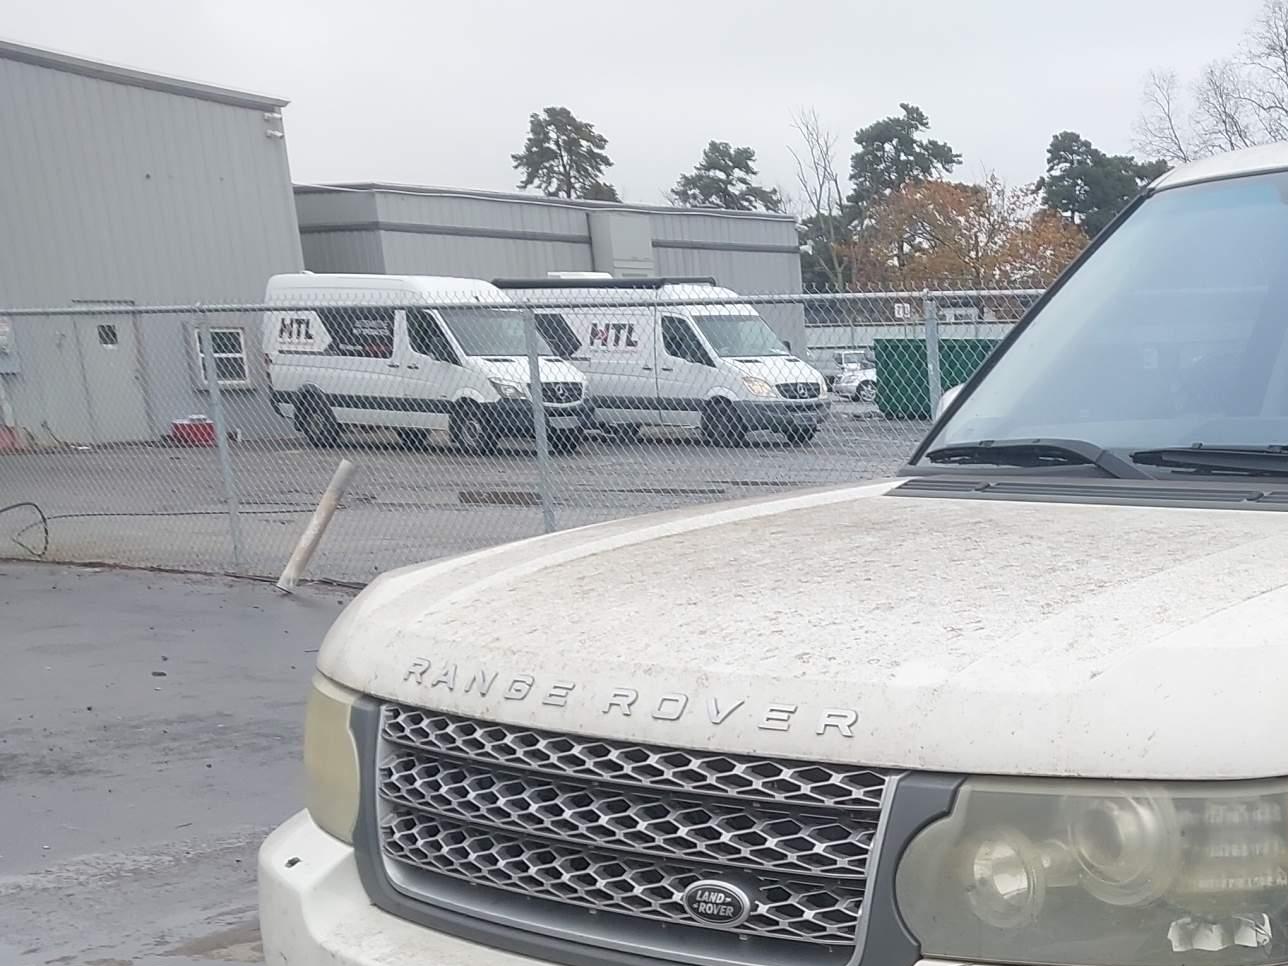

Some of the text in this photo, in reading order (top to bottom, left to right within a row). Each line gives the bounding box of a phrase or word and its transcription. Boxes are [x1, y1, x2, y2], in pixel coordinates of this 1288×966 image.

[403, 656, 859, 738] RANGE ROVER
[696, 890, 726, 904] LAND
[698, 902, 735, 918] ROVER
